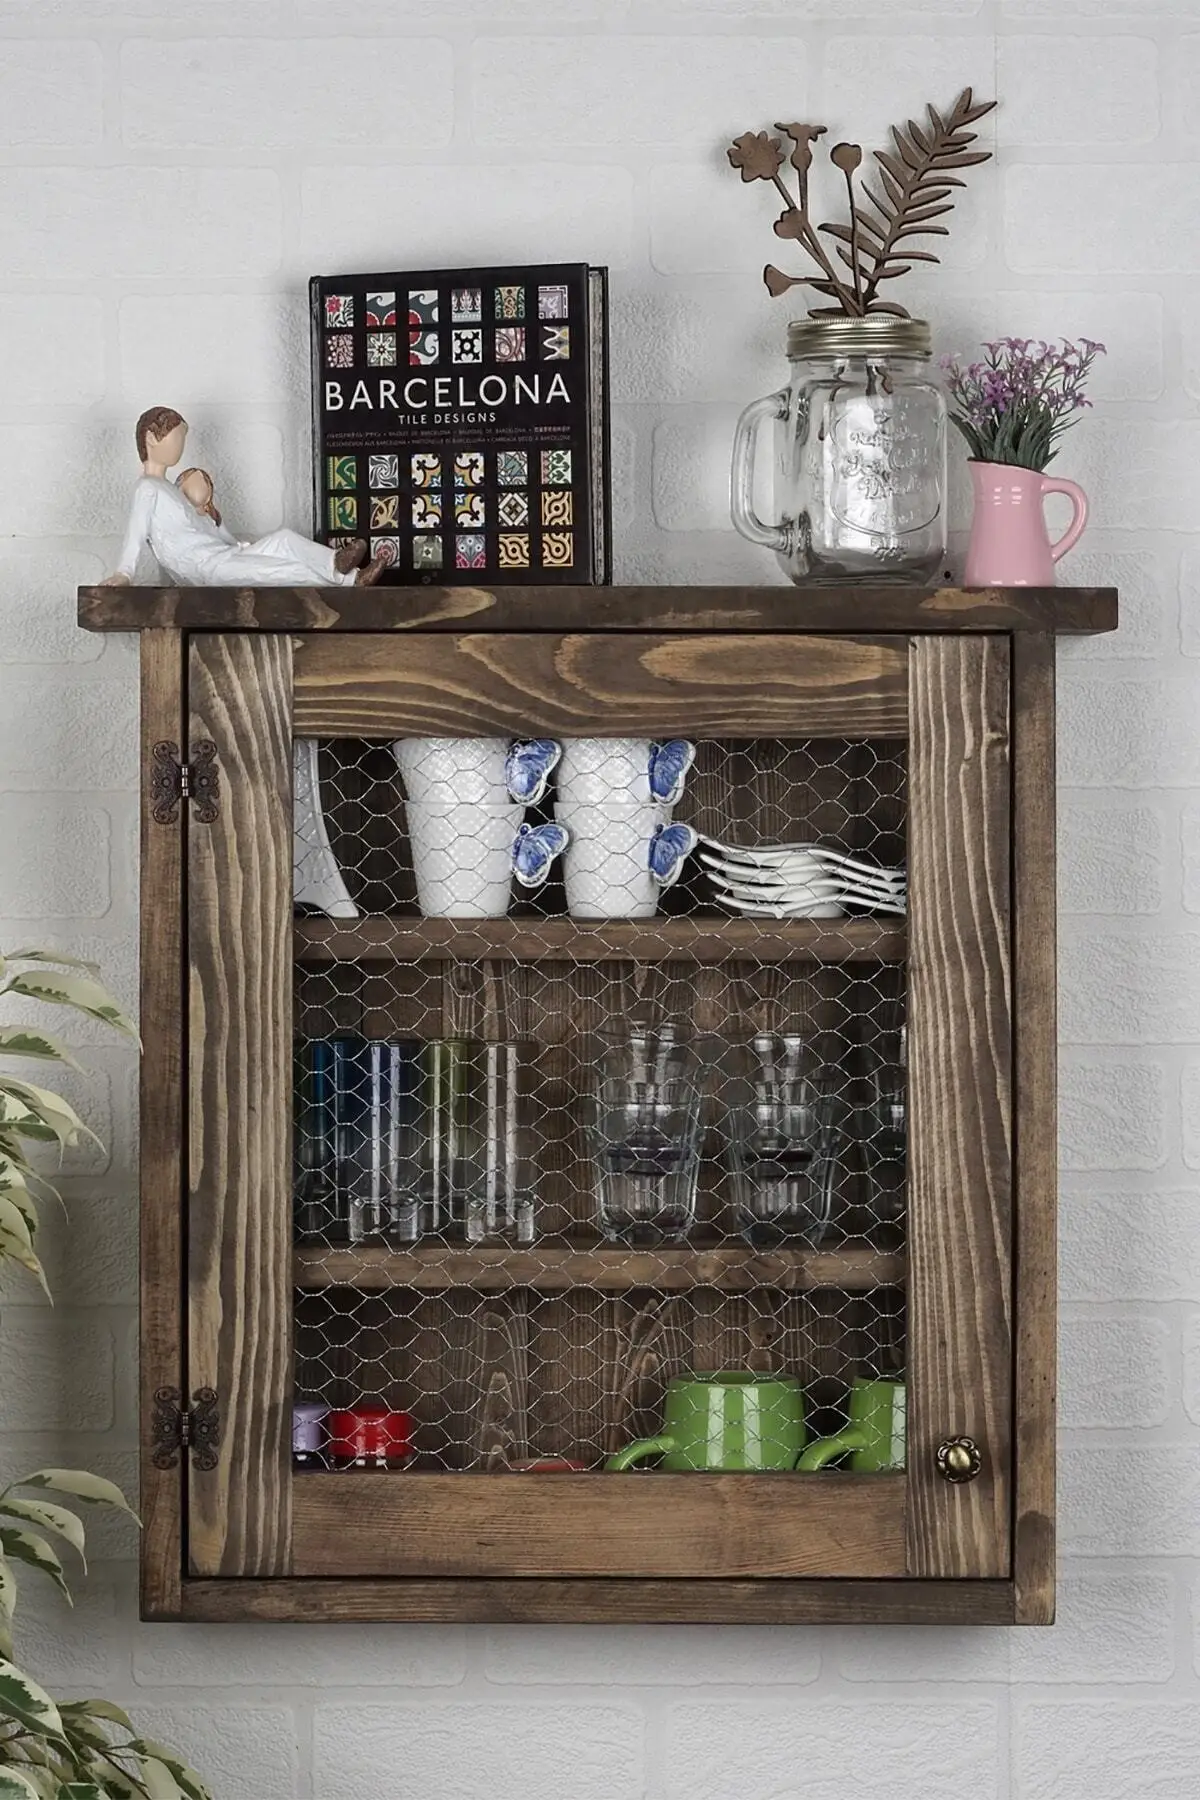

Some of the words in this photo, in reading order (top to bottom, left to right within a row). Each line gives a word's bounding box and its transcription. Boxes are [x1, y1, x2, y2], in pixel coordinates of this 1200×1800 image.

[325, 373, 571, 411] BARCELONA
[398, 414, 427, 425] TILE
[434, 412, 496, 424] DESIGNS
